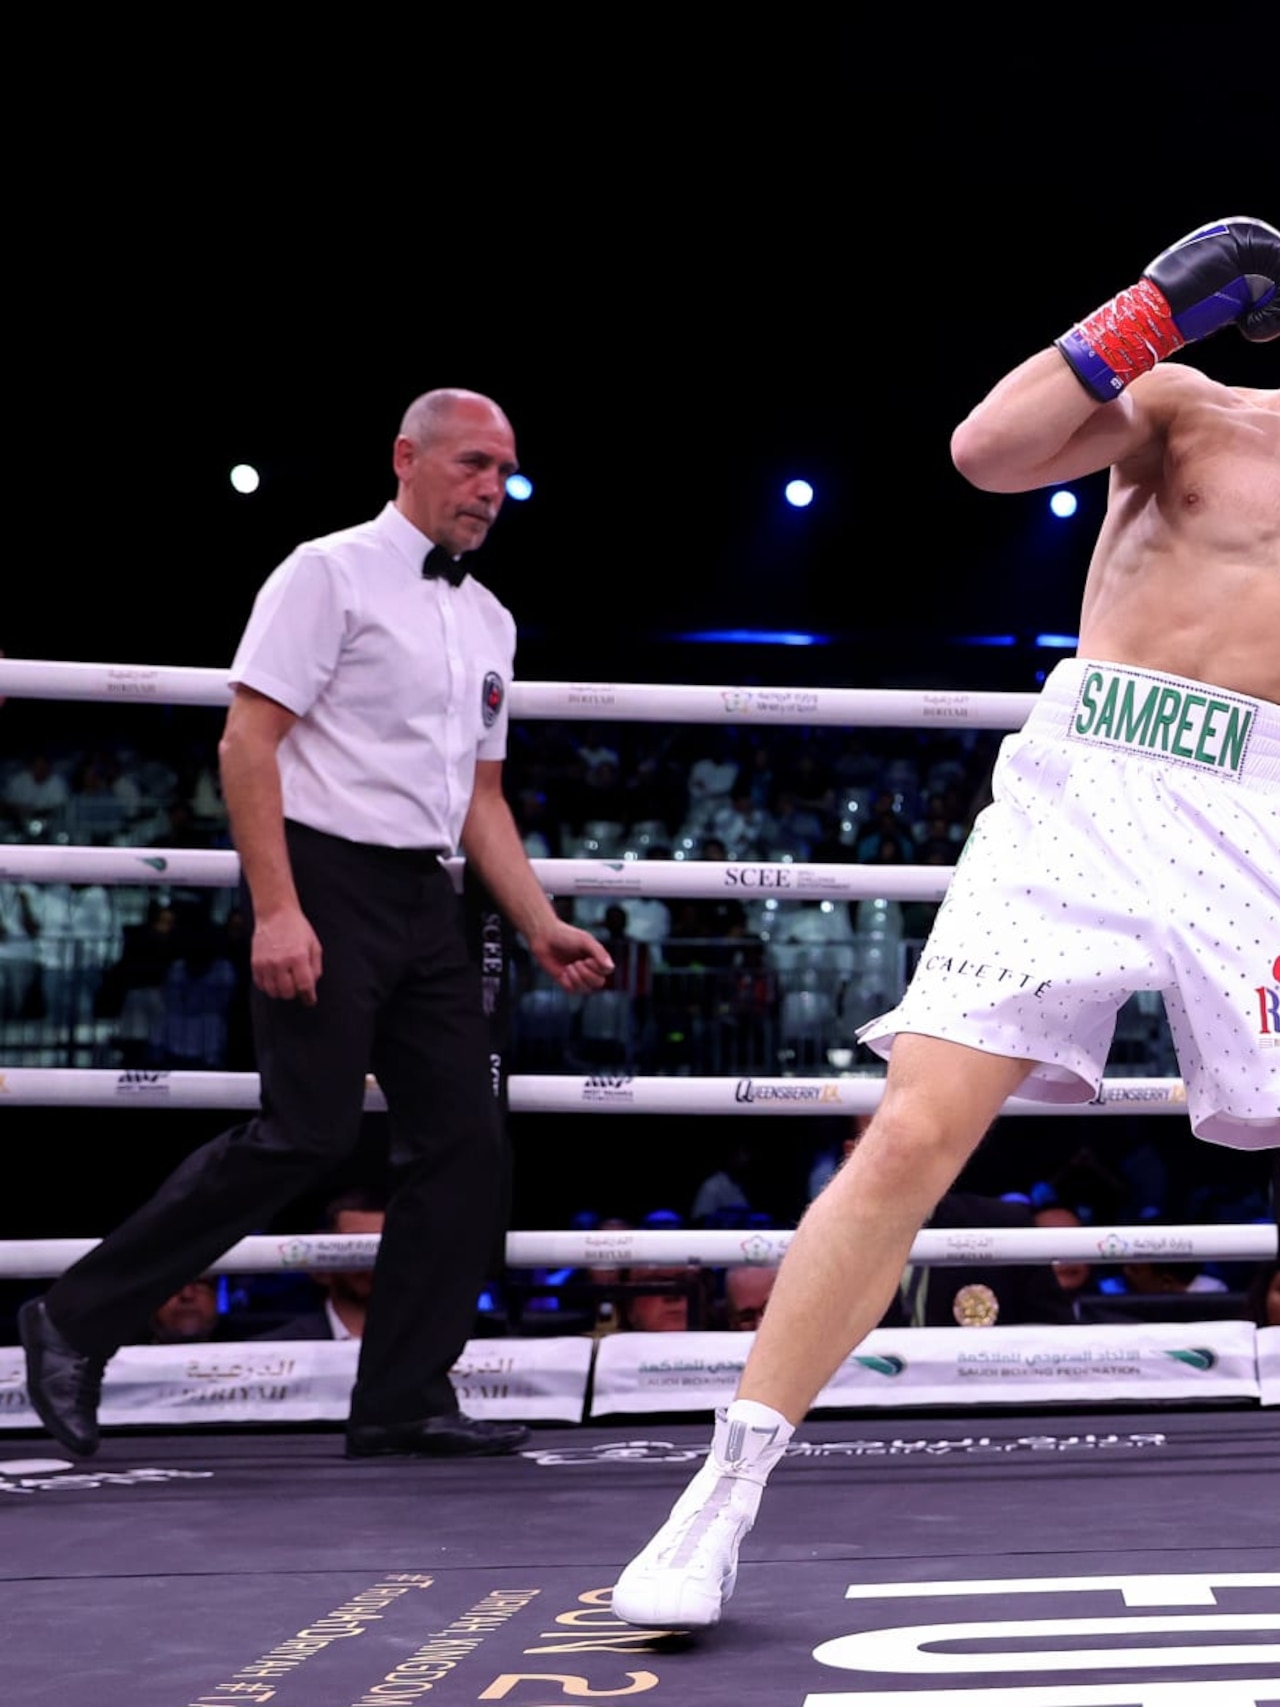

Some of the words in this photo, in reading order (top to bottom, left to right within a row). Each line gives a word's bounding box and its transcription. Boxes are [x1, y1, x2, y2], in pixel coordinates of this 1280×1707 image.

[1076, 672, 1252, 771] SAMREEN
[724, 867, 791, 889] SCEE
[735, 1080, 821, 1103] QUEENSBERRY
[957, 1366, 998, 1377] SAUDI
